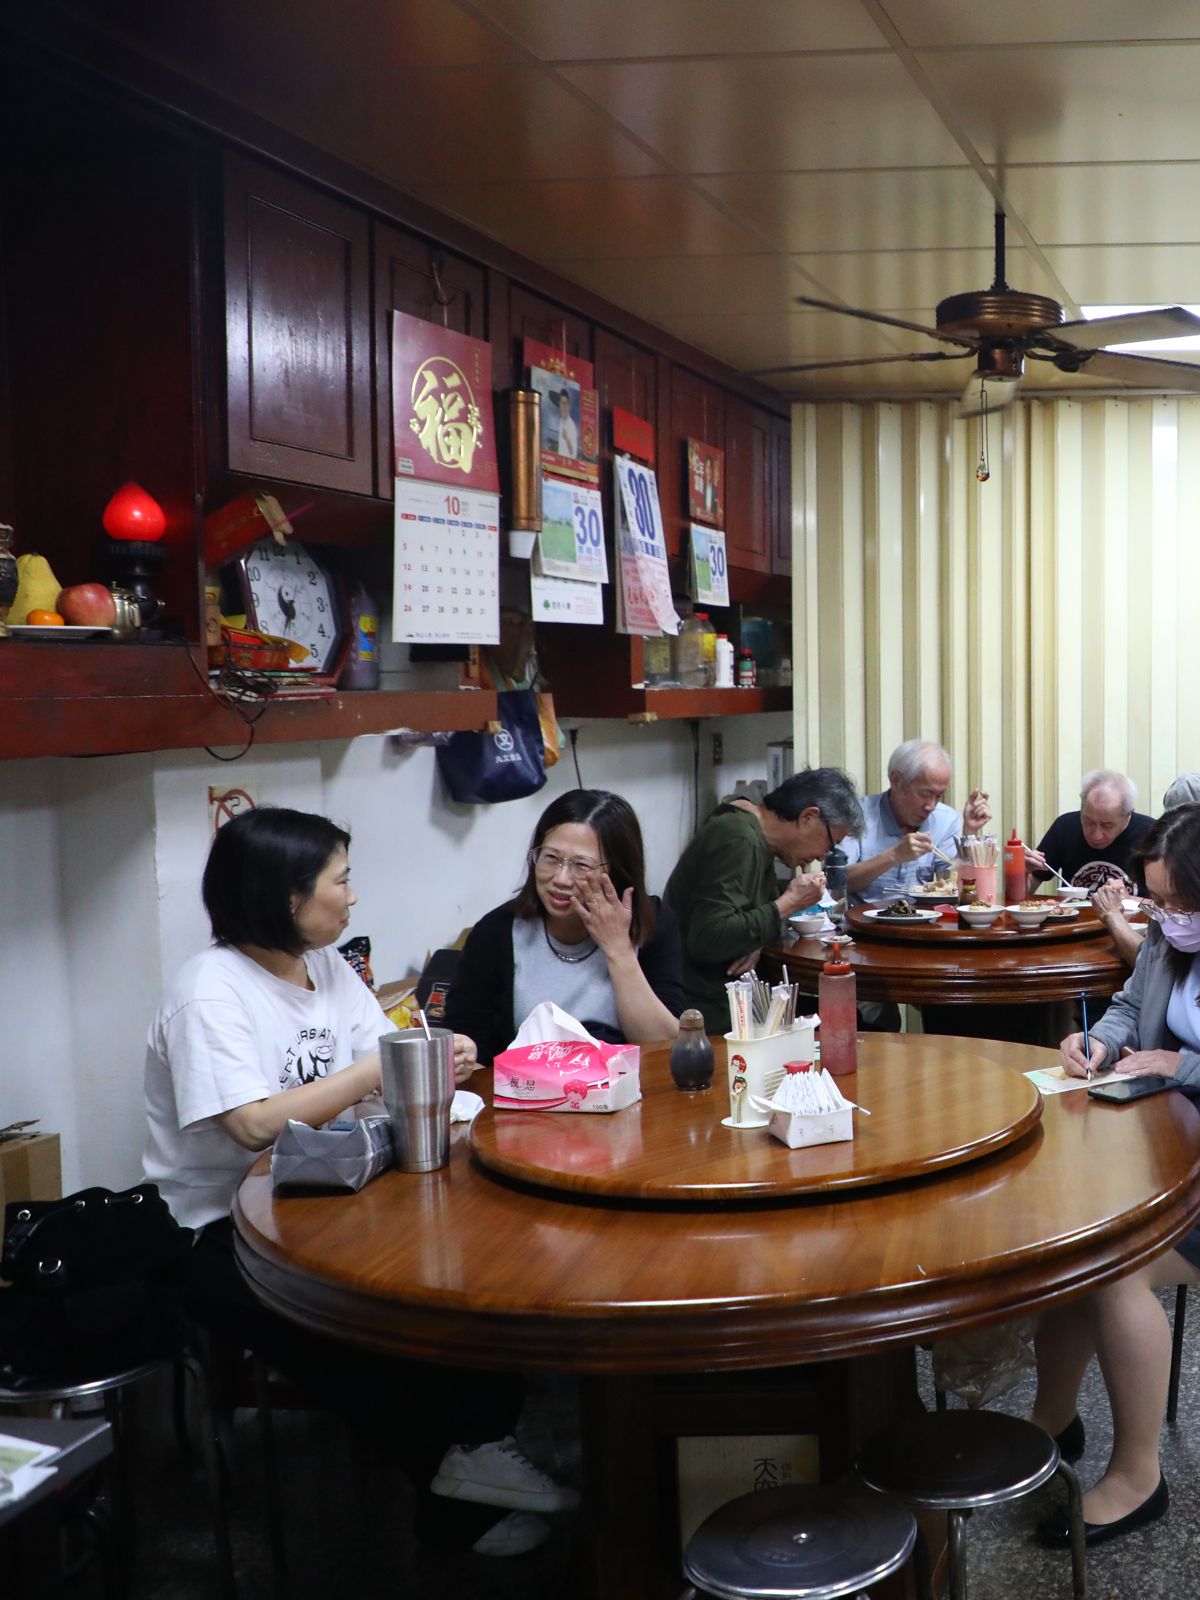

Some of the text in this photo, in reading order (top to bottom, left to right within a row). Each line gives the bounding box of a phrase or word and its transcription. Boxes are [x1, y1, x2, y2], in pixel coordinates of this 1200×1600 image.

[413, 370, 474, 474] 福
[445, 496, 460, 516] 10
[628, 468, 656, 541] 30
[574, 506, 601, 547] 30
[404, 563, 412, 571] 12
[710, 545, 724, 577] 30
[308, 571, 317, 586] 2
[404, 584, 412, 592] 19
[317, 597, 325, 613] 3
[404, 604, 412, 612] 26
[422, 605, 429, 613] 27
[318, 624, 326, 638] 4
[310, 644, 318, 658] 5
